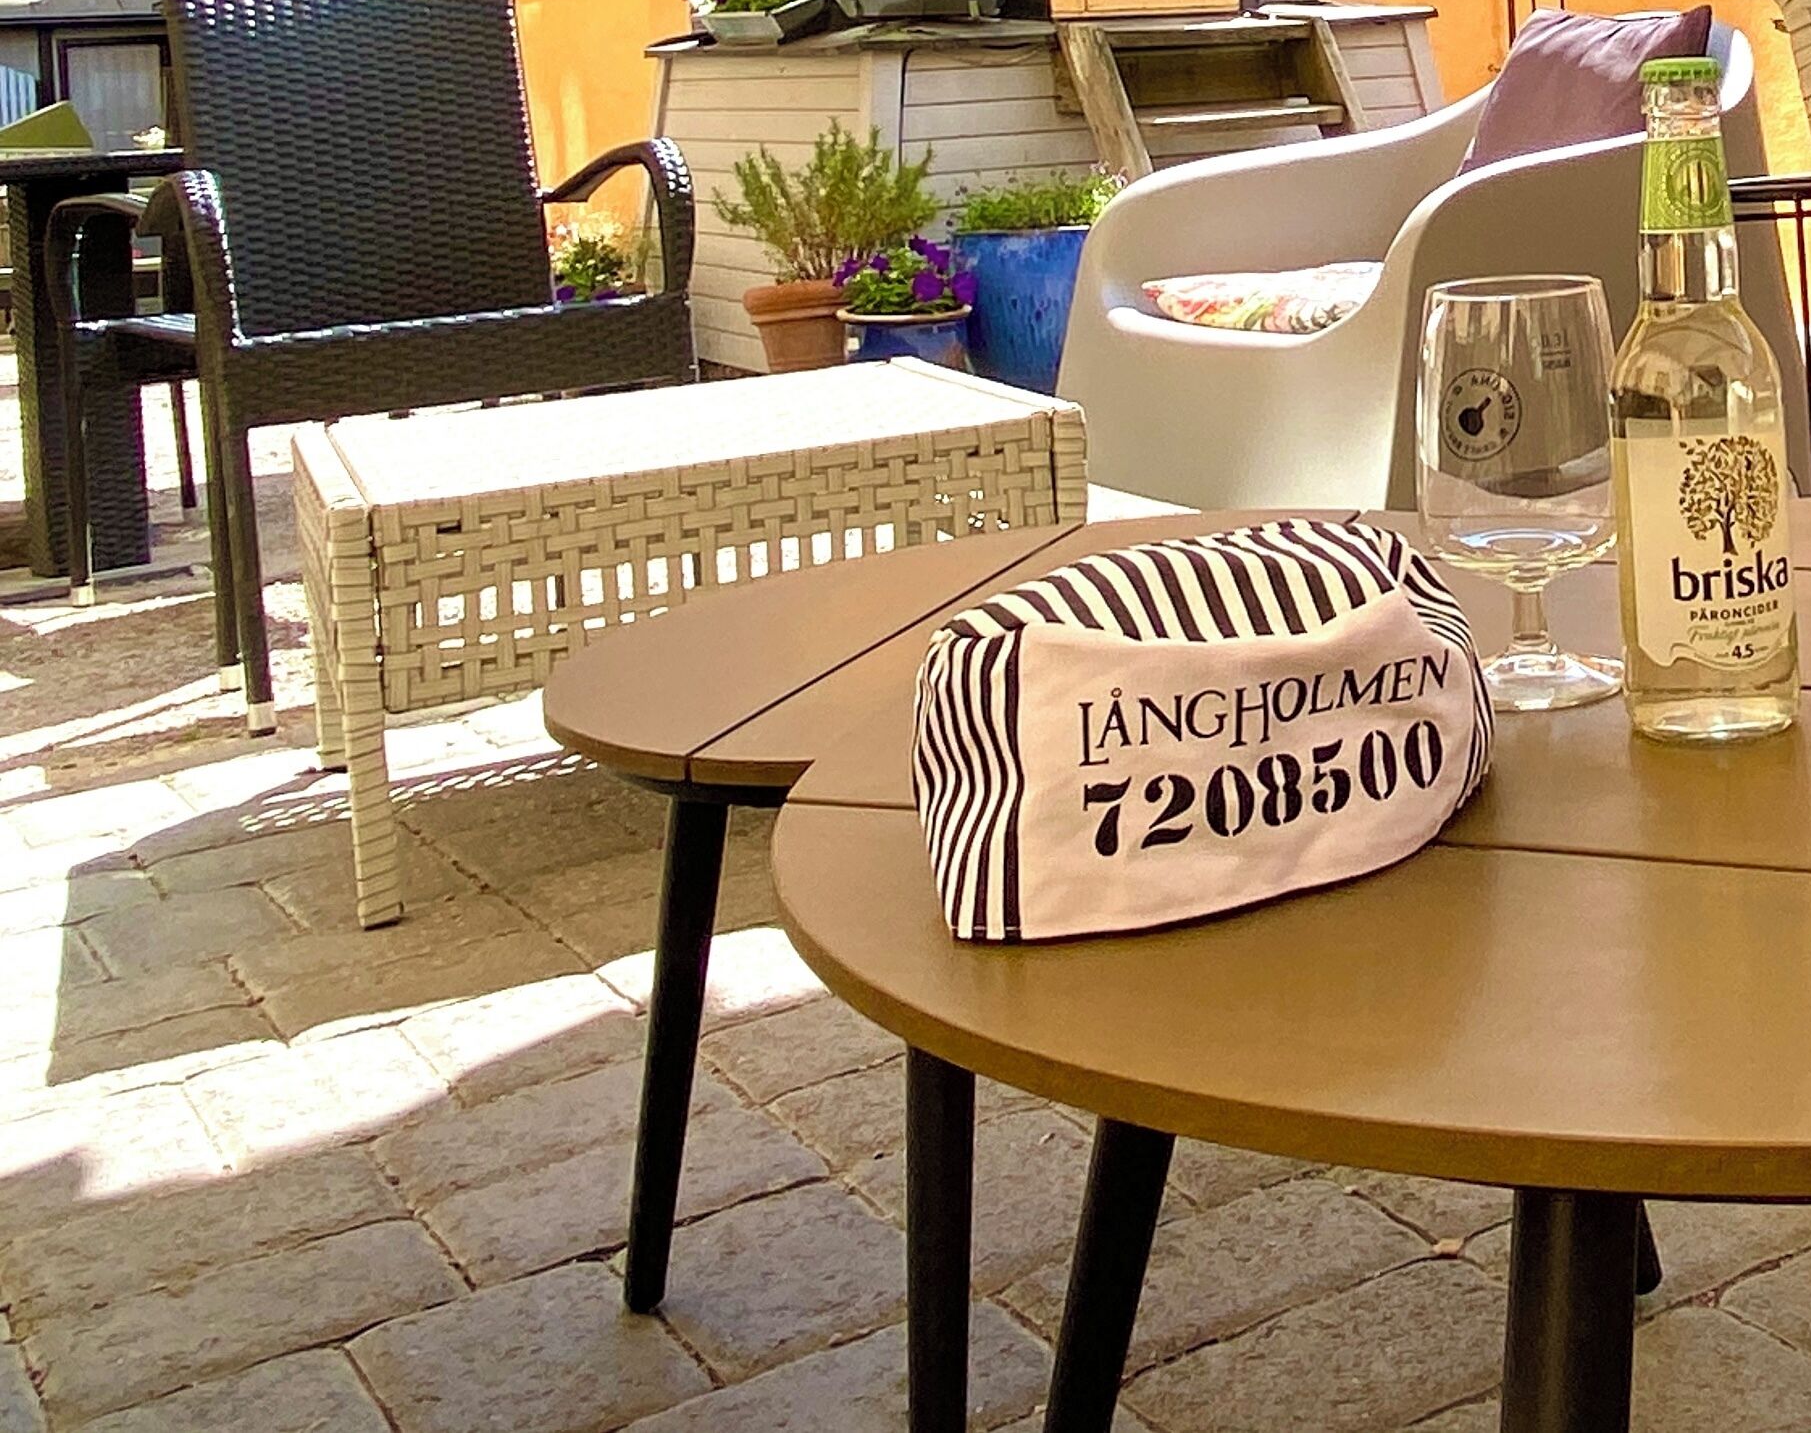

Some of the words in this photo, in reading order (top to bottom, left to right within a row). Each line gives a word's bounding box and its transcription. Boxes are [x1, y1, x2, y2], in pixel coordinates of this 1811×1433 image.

[1671, 550, 1788, 602] briska
[1690, 600, 1779, 621] PÄRONCIDER
[1079, 648, 1451, 767] LÅNGHOLMEN
[1082, 719, 1444, 858] 7208500
